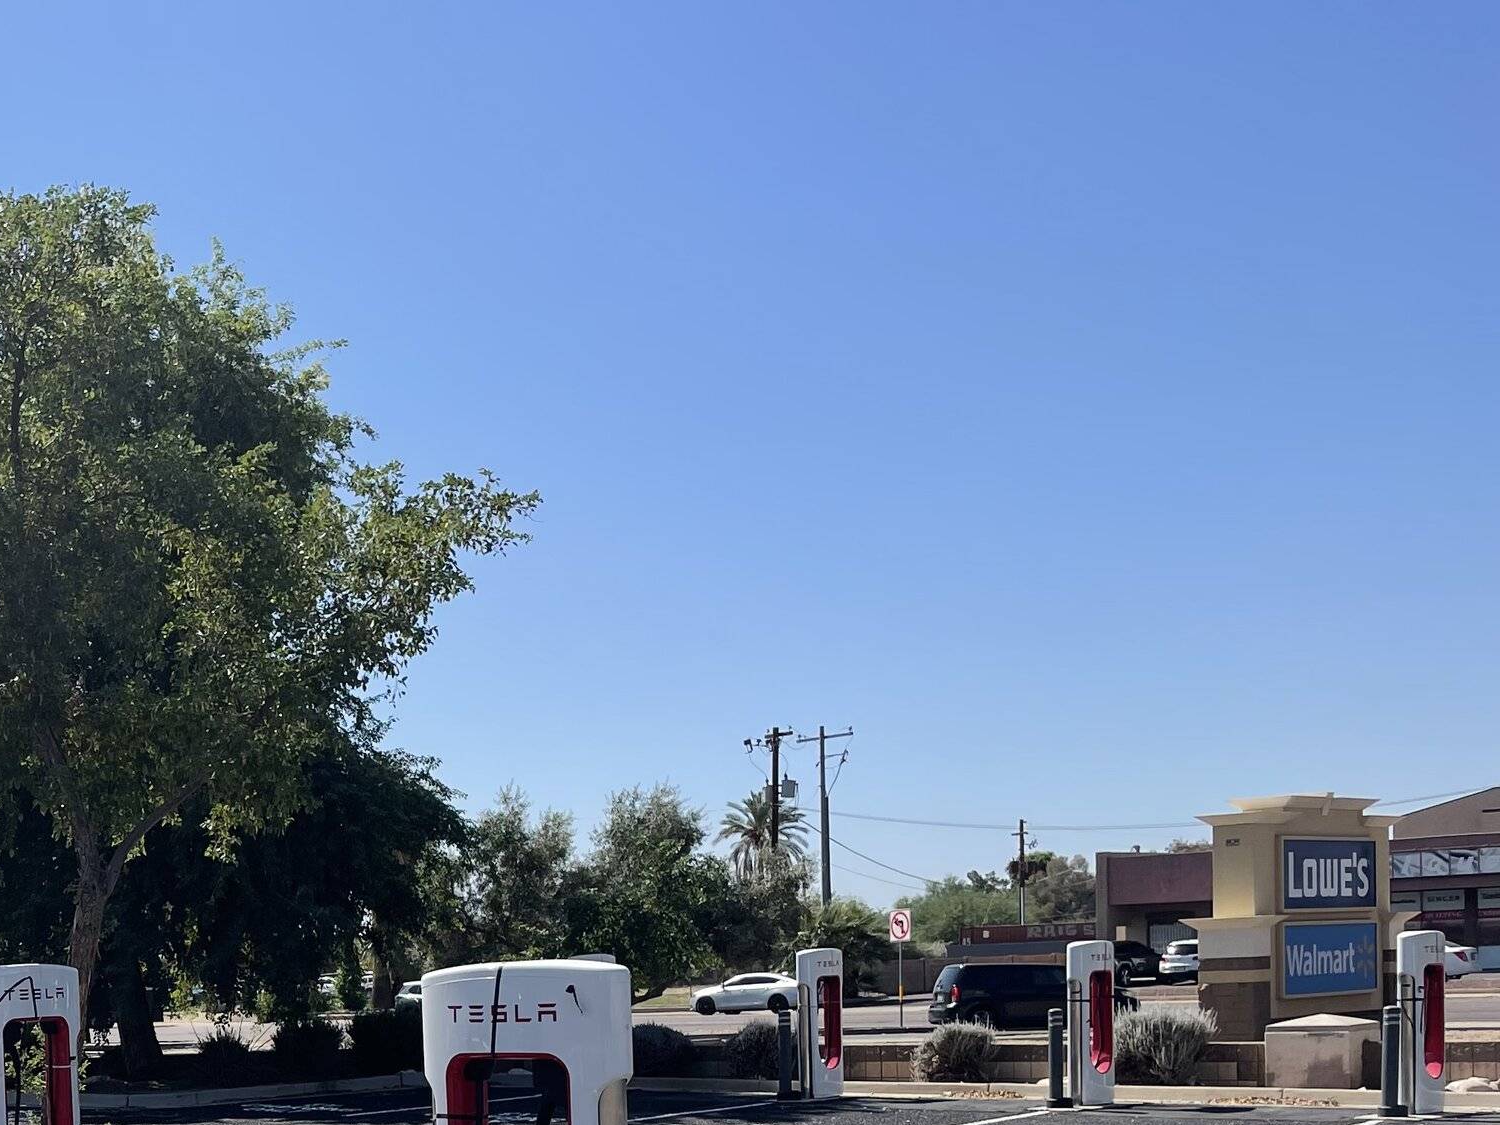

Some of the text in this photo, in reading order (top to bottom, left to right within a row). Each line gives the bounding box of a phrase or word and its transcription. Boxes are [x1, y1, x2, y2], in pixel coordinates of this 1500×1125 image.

[1288, 851, 1370, 898] LOWE'S
[1287, 942, 1356, 977] Walmart
[4, 987, 65, 1001] TESLA
[447, 1003, 557, 1023] TESLA
